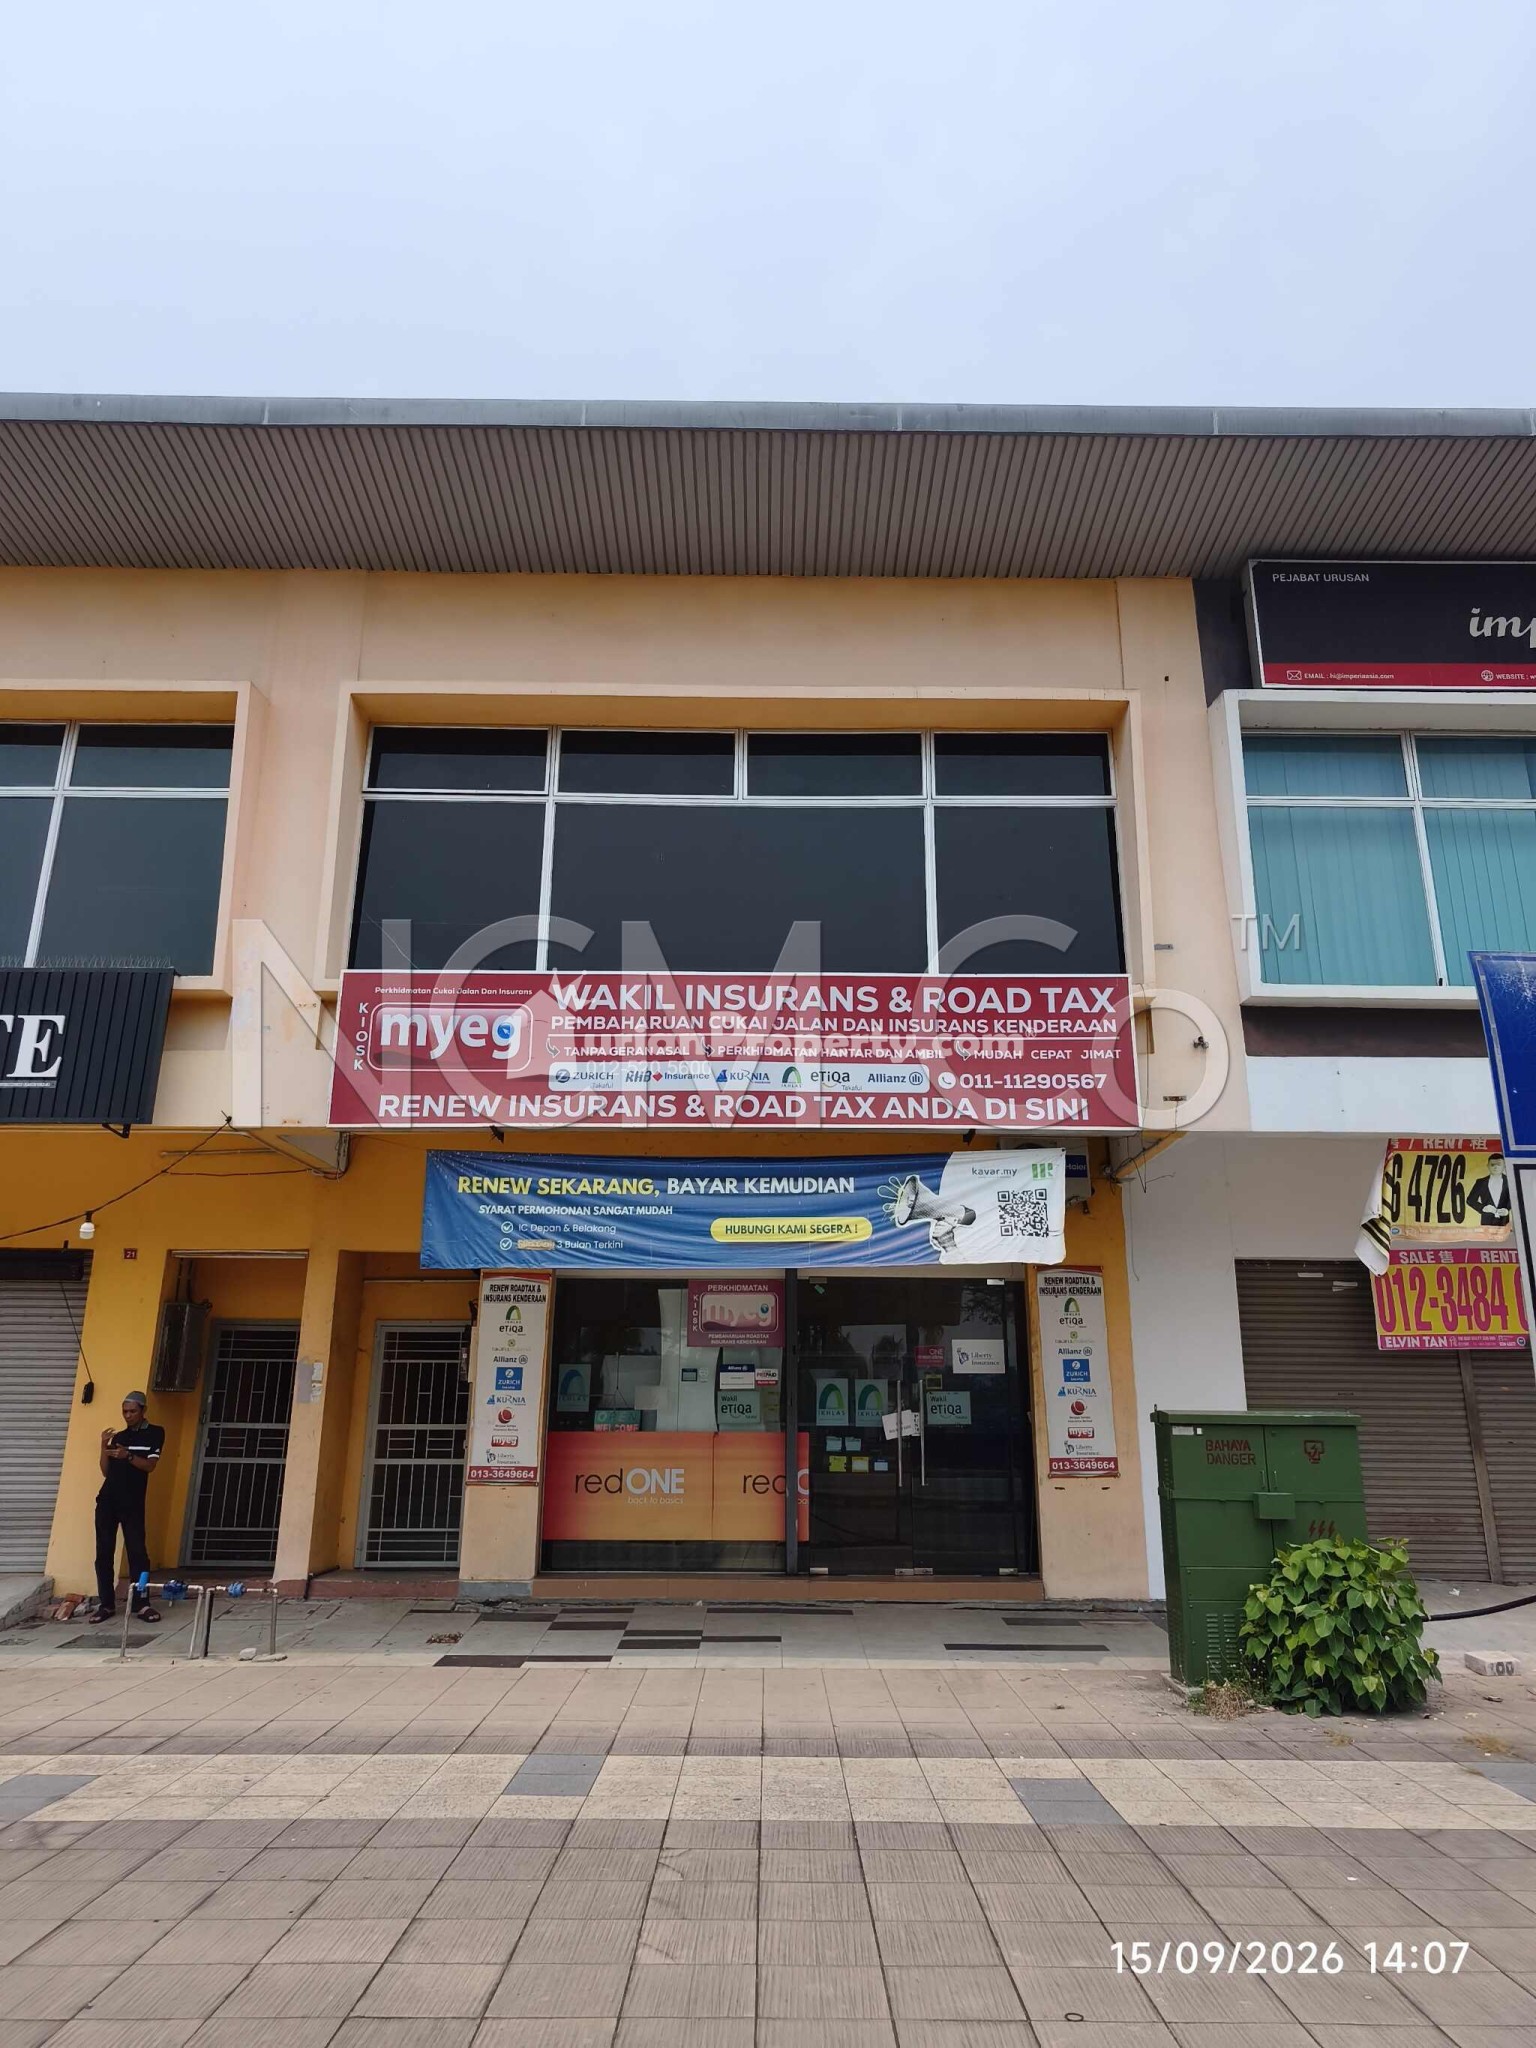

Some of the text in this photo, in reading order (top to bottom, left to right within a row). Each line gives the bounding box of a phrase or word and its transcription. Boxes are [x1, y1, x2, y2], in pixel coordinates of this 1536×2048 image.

[1272, 574, 1370, 582] PEJABAT URUSAN
[375, 986, 431, 995] Perkhidmatan
[433, 987, 455, 995] Cukai
[499, 988, 533, 996] Insurans
[552, 984, 1116, 1014] WAKIL INSURANS & ROAD TAX
[551, 1015, 1117, 1034] PEMBAHARUAN CUKAI JALAN DAN INSURANS KENDERAAN
[380, 1013, 522, 1060] myeg
[563, 1046, 690, 1056] TANPA GERAN ASAL
[718, 1045, 945, 1059] PERKHIDMATAN HANTAR DAN AMBIL
[974, 1049, 1121, 1060] MUDAH CEPAT JIMAT
[573, 1072, 614, 1081] ZURICH
[625, 1070, 710, 1083] RHB Insurance
[867, 1073, 907, 1083] Allianz
[959, 1073, 1108, 1090] 011-11290567
[378, 1094, 1089, 1121] RENEW INSURANS & ROAD TAX ANDA DI SINI
[971, 1167, 1018, 1177] kavar.my
[457, 1176, 855, 1198] RENEW SEKARANG, BAYAR KEMUDIAN
[1407, 1153, 1466, 1224] 4726
[478, 1204, 673, 1216] SYARAT PERMOHONAN SANGAT MUDAH
[518, 1224, 617, 1234] IC Depan & Belakang
[725, 1224, 776, 1235] HUBUNGI
[777, 1224, 807, 1234] KAMI
[809, 1224, 852, 1234] SEGERA
[556, 1240, 563, 1249] 3
[564, 1240, 592, 1249] Bulan
[594, 1240, 624, 1249] Terkini
[1399, 1251, 1436, 1264] SALE
[1480, 1250, 1518, 1263] RENT
[1043, 1276, 1064, 1285] RENEW
[1064, 1276, 1090, 1285] ROADTAX
[490, 1284, 509, 1293] RENEW
[510, 1284, 536, 1293] ROADTAX
[707, 1284, 769, 1292] PERKHIDMATAN
[1039, 1286, 1102, 1295] INSURANS KENDERAAN
[483, 1294, 547, 1303] INSURANS KENDERAAN
[1385, 1336, 1421, 1348] ELVIN
[1422, 1336, 1448, 1347] TAN
[493, 1355, 518, 1363] Allianz
[1205, 1439, 1251, 1452] BAHAYA
[1206, 1452, 1256, 1466] DANGER
[1052, 1461, 1115, 1470] 013-3649664
[470, 1469, 535, 1478] 013-3649664
[574, 1467, 684, 1495] redONE
